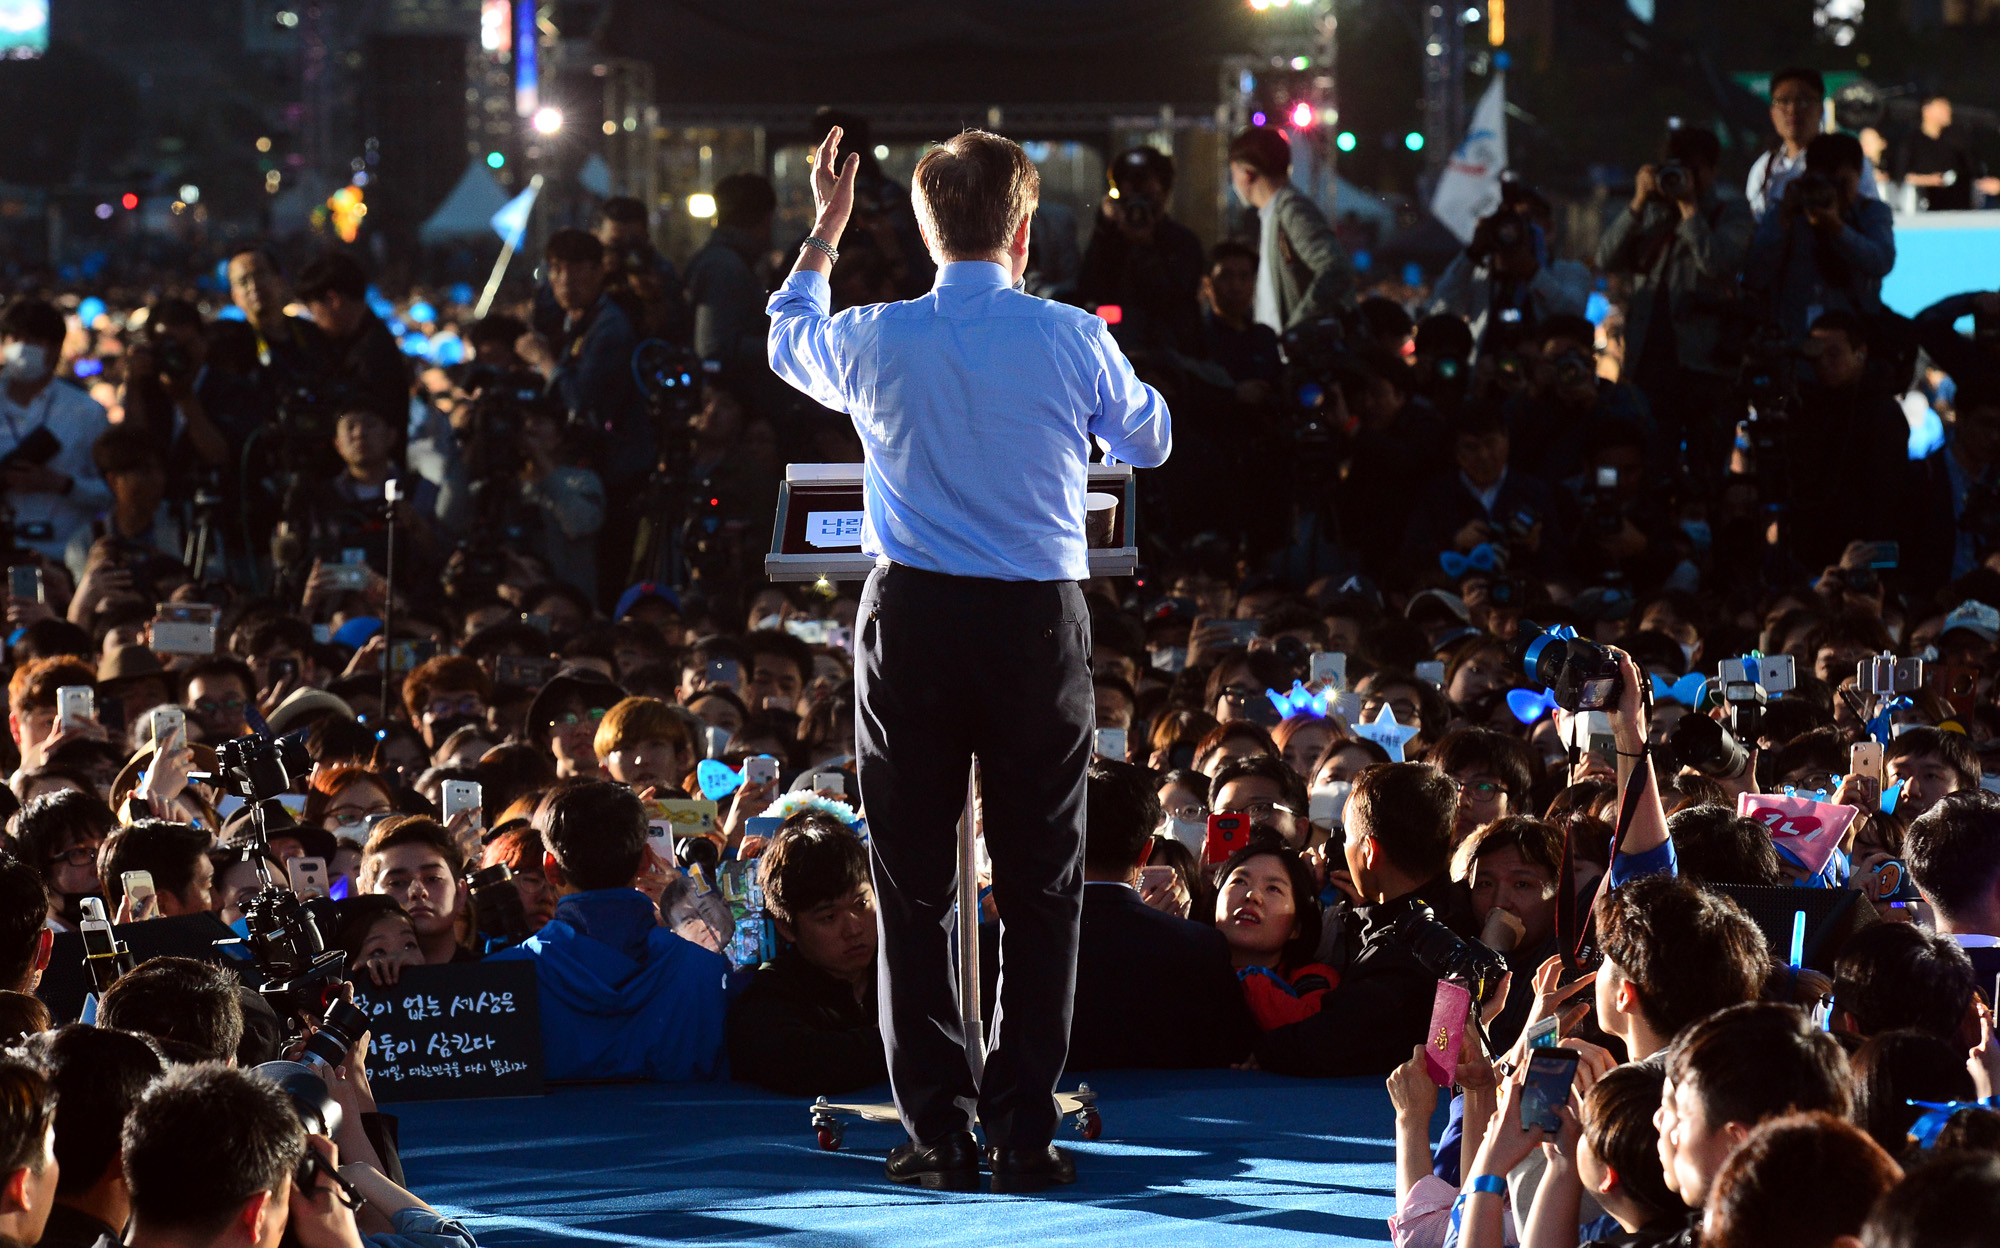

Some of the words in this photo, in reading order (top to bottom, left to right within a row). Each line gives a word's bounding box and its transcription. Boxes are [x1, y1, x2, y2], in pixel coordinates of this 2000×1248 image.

[403, 994, 441, 1020] 없는
[450, 991, 516, 1017] 세상은
[426, 1032, 495, 1058] 삼킨다
[408, 1061, 462, 1078] 대한민국을
[464, 1064, 487, 1075] 다시
